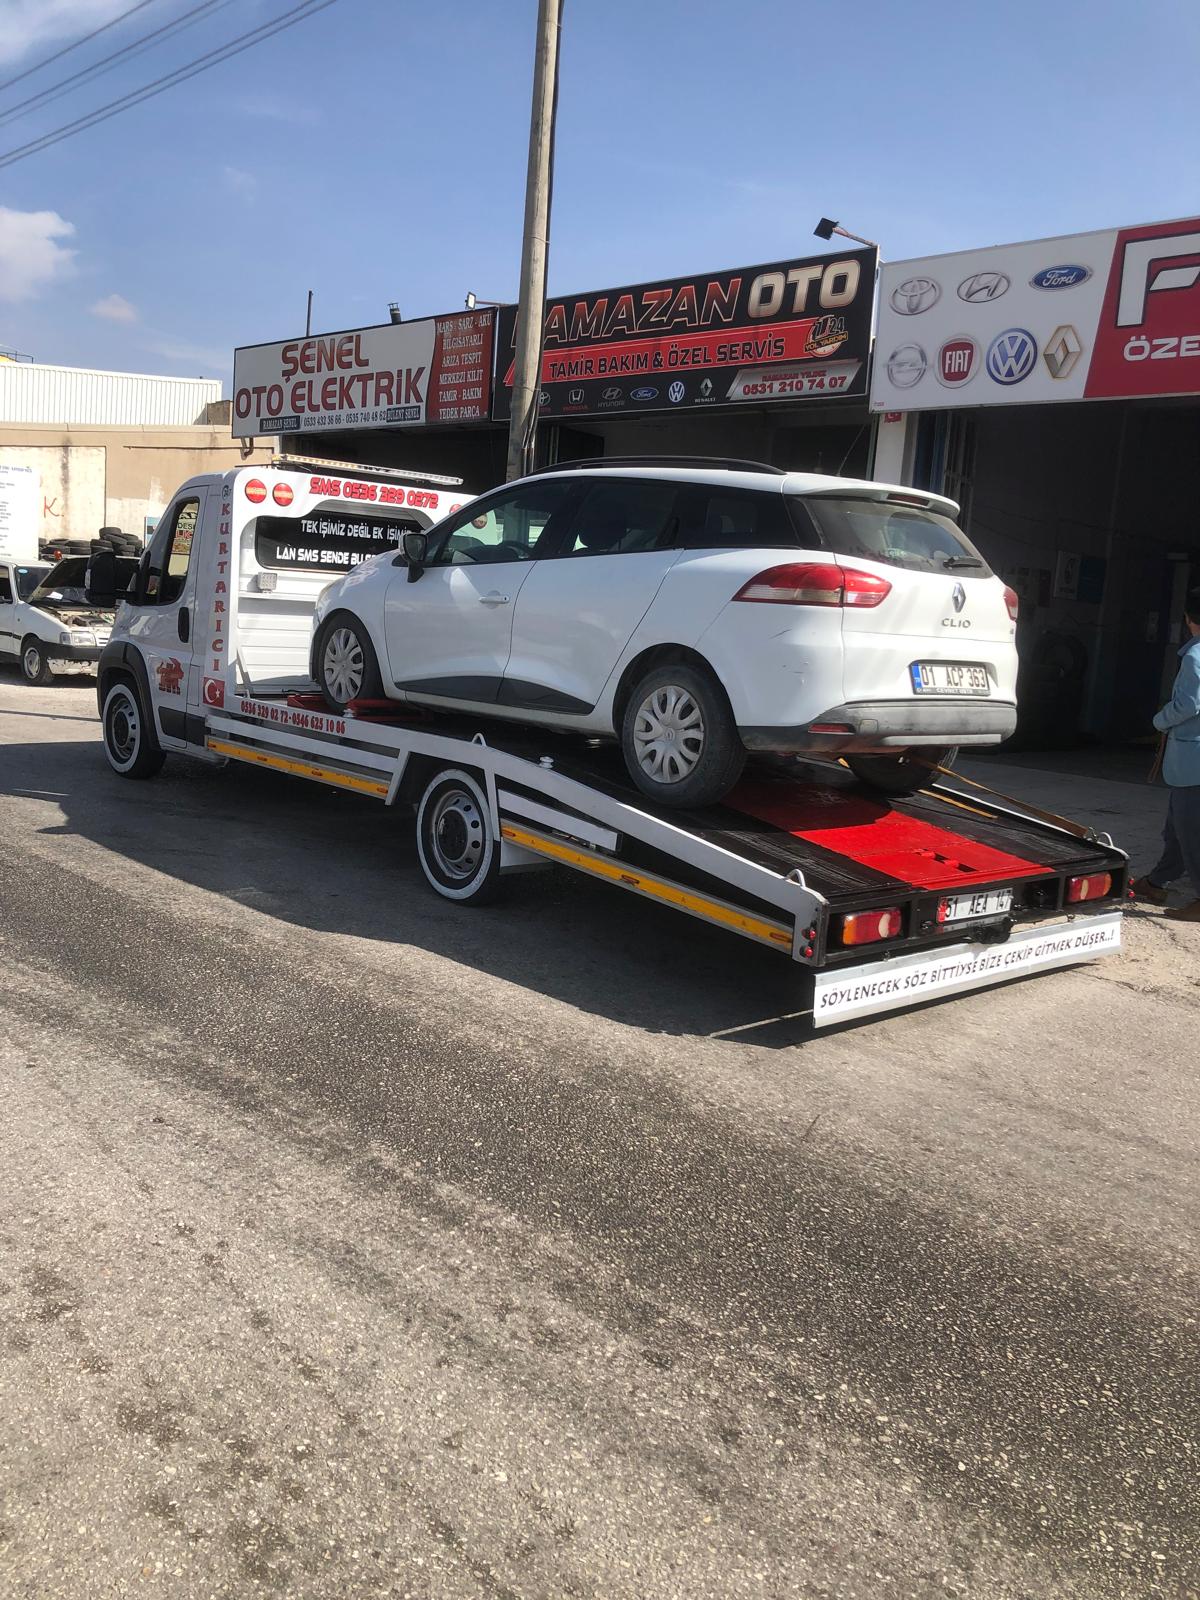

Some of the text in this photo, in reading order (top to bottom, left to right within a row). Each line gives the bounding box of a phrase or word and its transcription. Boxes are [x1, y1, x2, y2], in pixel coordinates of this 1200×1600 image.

[1042, 269, 1077, 287] Ford
[511, 259, 861, 348] AMAZAN OTO
[549, 333, 785, 379] TAMİR BAKIM & ÖZEL SERVİS
[805, 341, 820, 352] YOL
[281, 334, 370, 384] ŞENEL
[945, 350, 971, 373] FIAT
[235, 366, 426, 419] OTO ELEKTRİK
[743, 375, 848, 395] 0531 210 74 07
[439, 408, 459, 419] YEDEK
[309, 477, 439, 509] SMS 0536 329 0272
[301, 520, 318, 533] TEK
[319, 518, 345, 538] İŞİMİZ
[347, 522, 371, 538] DEĞİL
[373, 527, 383, 539] EK
[298, 548, 319, 562] SMS
[320, 550, 349, 565] SENDE
[212, 503, 231, 671] KURTARICI
[942, 618, 971, 629] CLIO
[921, 665, 986, 688] 01 ACP 363
[270, 708, 279, 720] 02
[325, 719, 335, 732] 10
[969, 894, 988, 915] AEA
[996, 889, 1011, 910] 147
[820, 979, 901, 1008] SÖYLENECEK
[904, 970, 927, 989] SÖZ
[979, 954, 1001, 972] BİZE
[1004, 945, 1033, 968] ÇEKİP
[1035, 940, 1071, 956] GİTMEK
